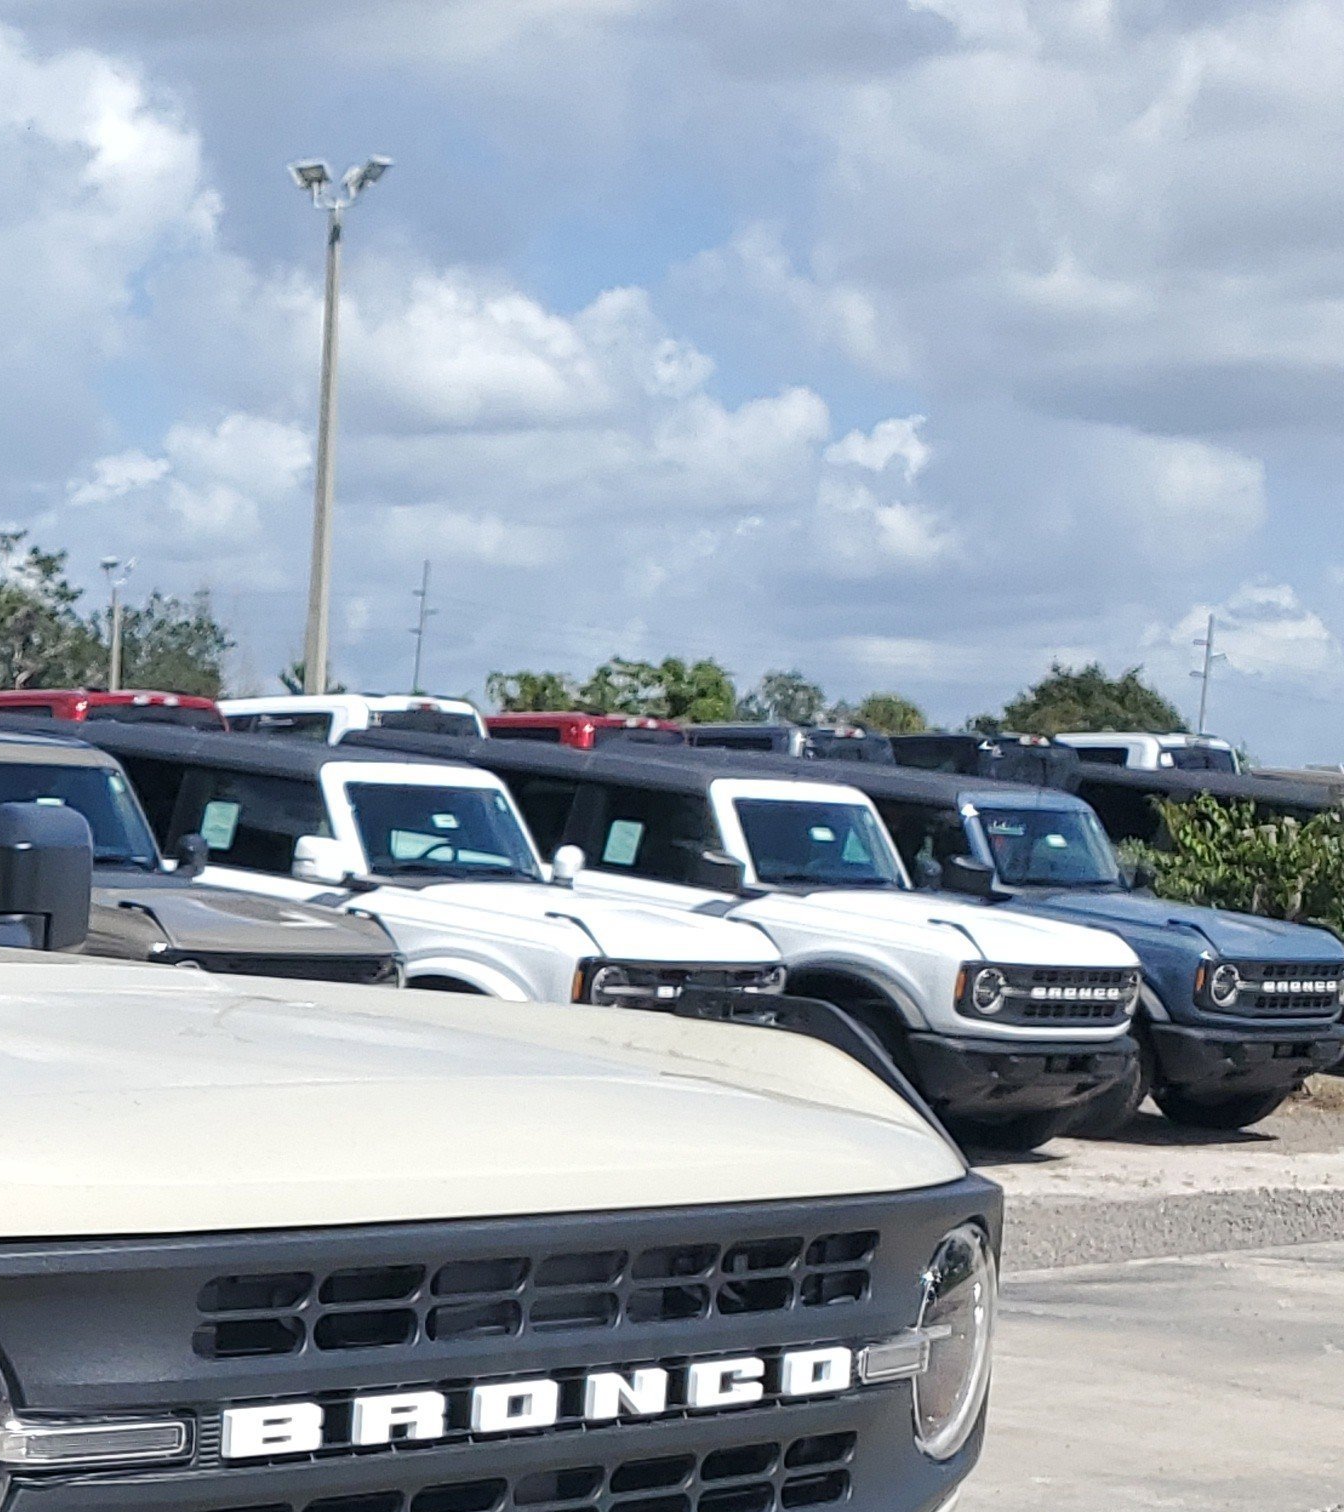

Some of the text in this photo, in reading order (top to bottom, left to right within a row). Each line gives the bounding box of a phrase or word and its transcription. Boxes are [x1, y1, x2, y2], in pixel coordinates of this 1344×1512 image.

[1264, 980, 1337, 993] BRONCO
[1030, 987, 1120, 1000] BRONCO
[220, 1345, 852, 1459] BRONCO
